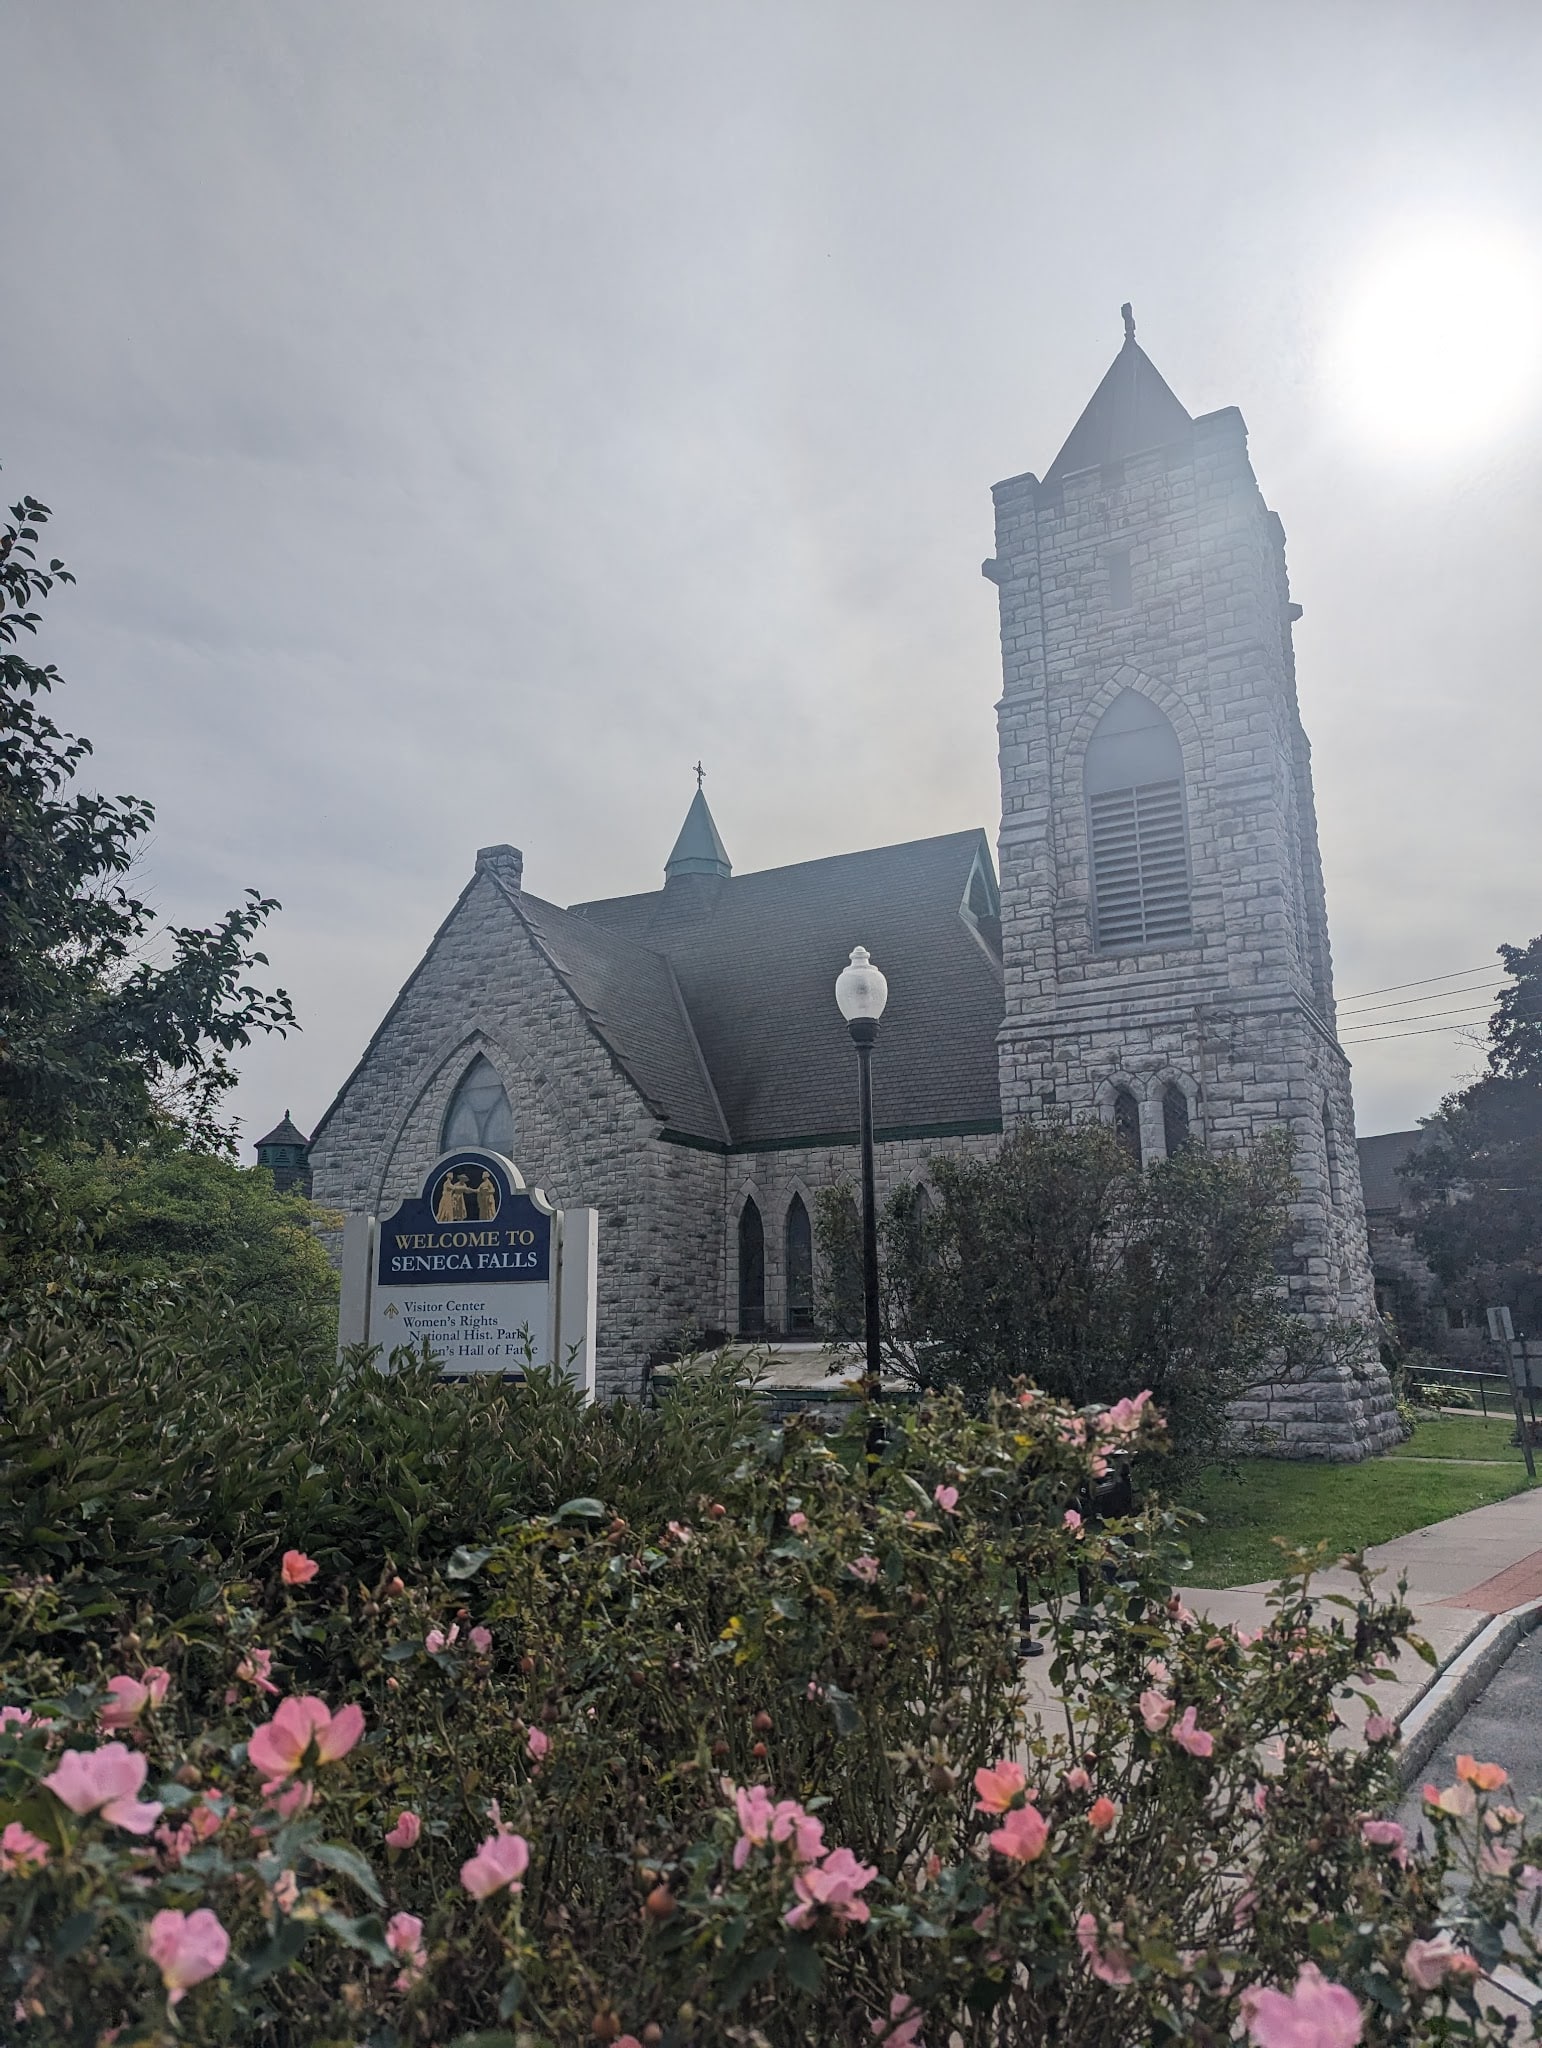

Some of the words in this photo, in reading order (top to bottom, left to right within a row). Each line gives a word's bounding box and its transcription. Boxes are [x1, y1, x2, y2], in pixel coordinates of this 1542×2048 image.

[395, 1231, 500, 1250] WELCOME
[505, 1230, 535, 1246] TO
[391, 1254, 473, 1272] SENECA
[477, 1252, 537, 1269] FALLS
[404, 1301, 443, 1312] Visitor
[446, 1301, 485, 1311] Center
[403, 1316, 456, 1328] Women's
[460, 1315, 498, 1329] Rights
[409, 1330, 460, 1341] National
[464, 1329, 493, 1341] Hist.
[497, 1328, 525, 1340] Park
[409, 1344, 455, 1356] omen's
[459, 1345, 484, 1356] Hall
[488, 1344, 501, 1356] of
